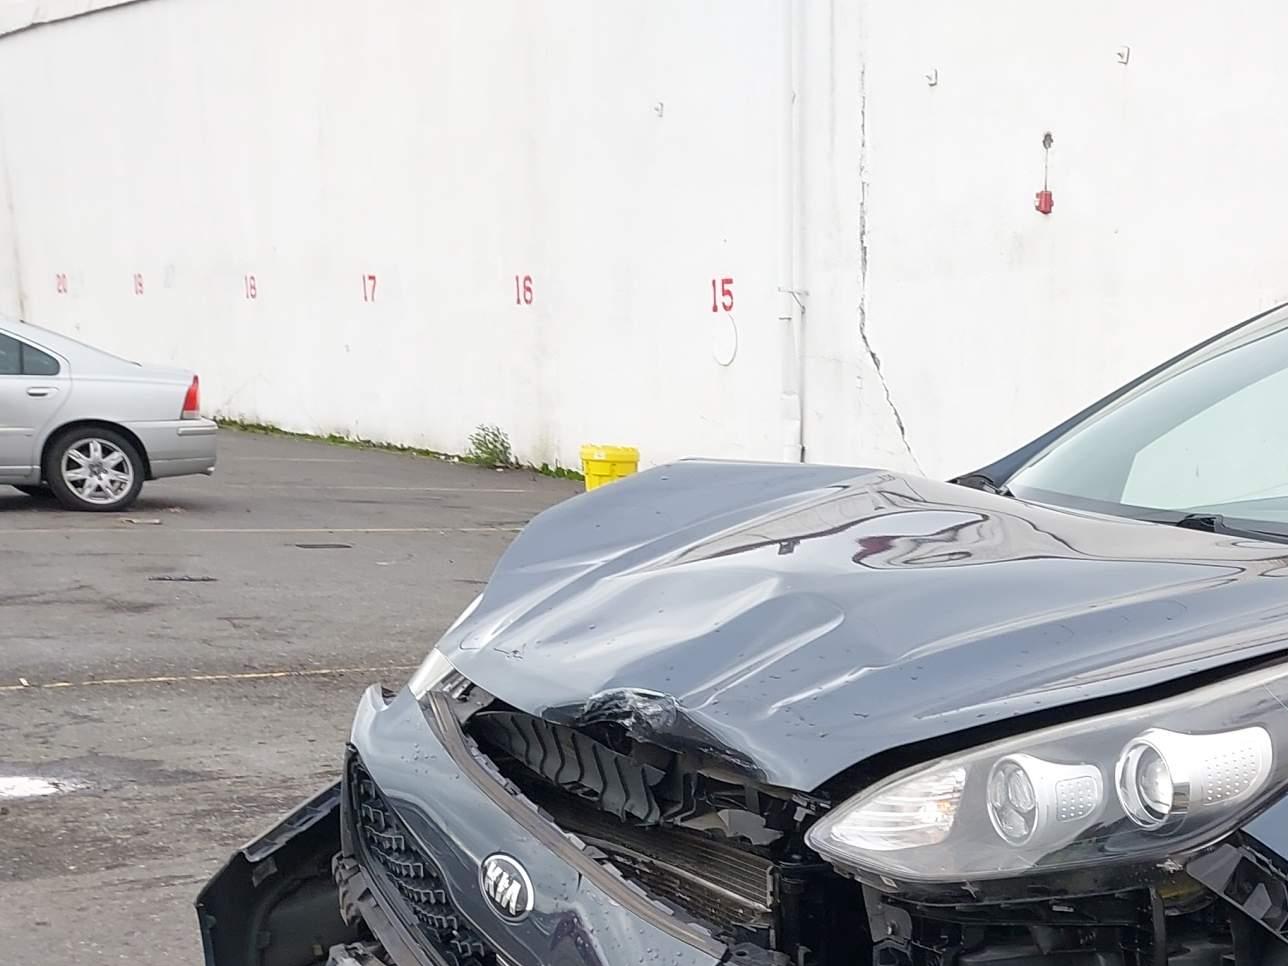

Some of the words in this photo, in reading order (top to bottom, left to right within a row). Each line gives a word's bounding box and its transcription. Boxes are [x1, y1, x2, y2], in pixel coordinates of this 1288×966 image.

[245, 276, 257, 299] 18
[362, 274, 377, 302] 17
[515, 275, 534, 305] 16
[711, 278, 735, 313] 15
[484, 860, 521, 915] KIA
